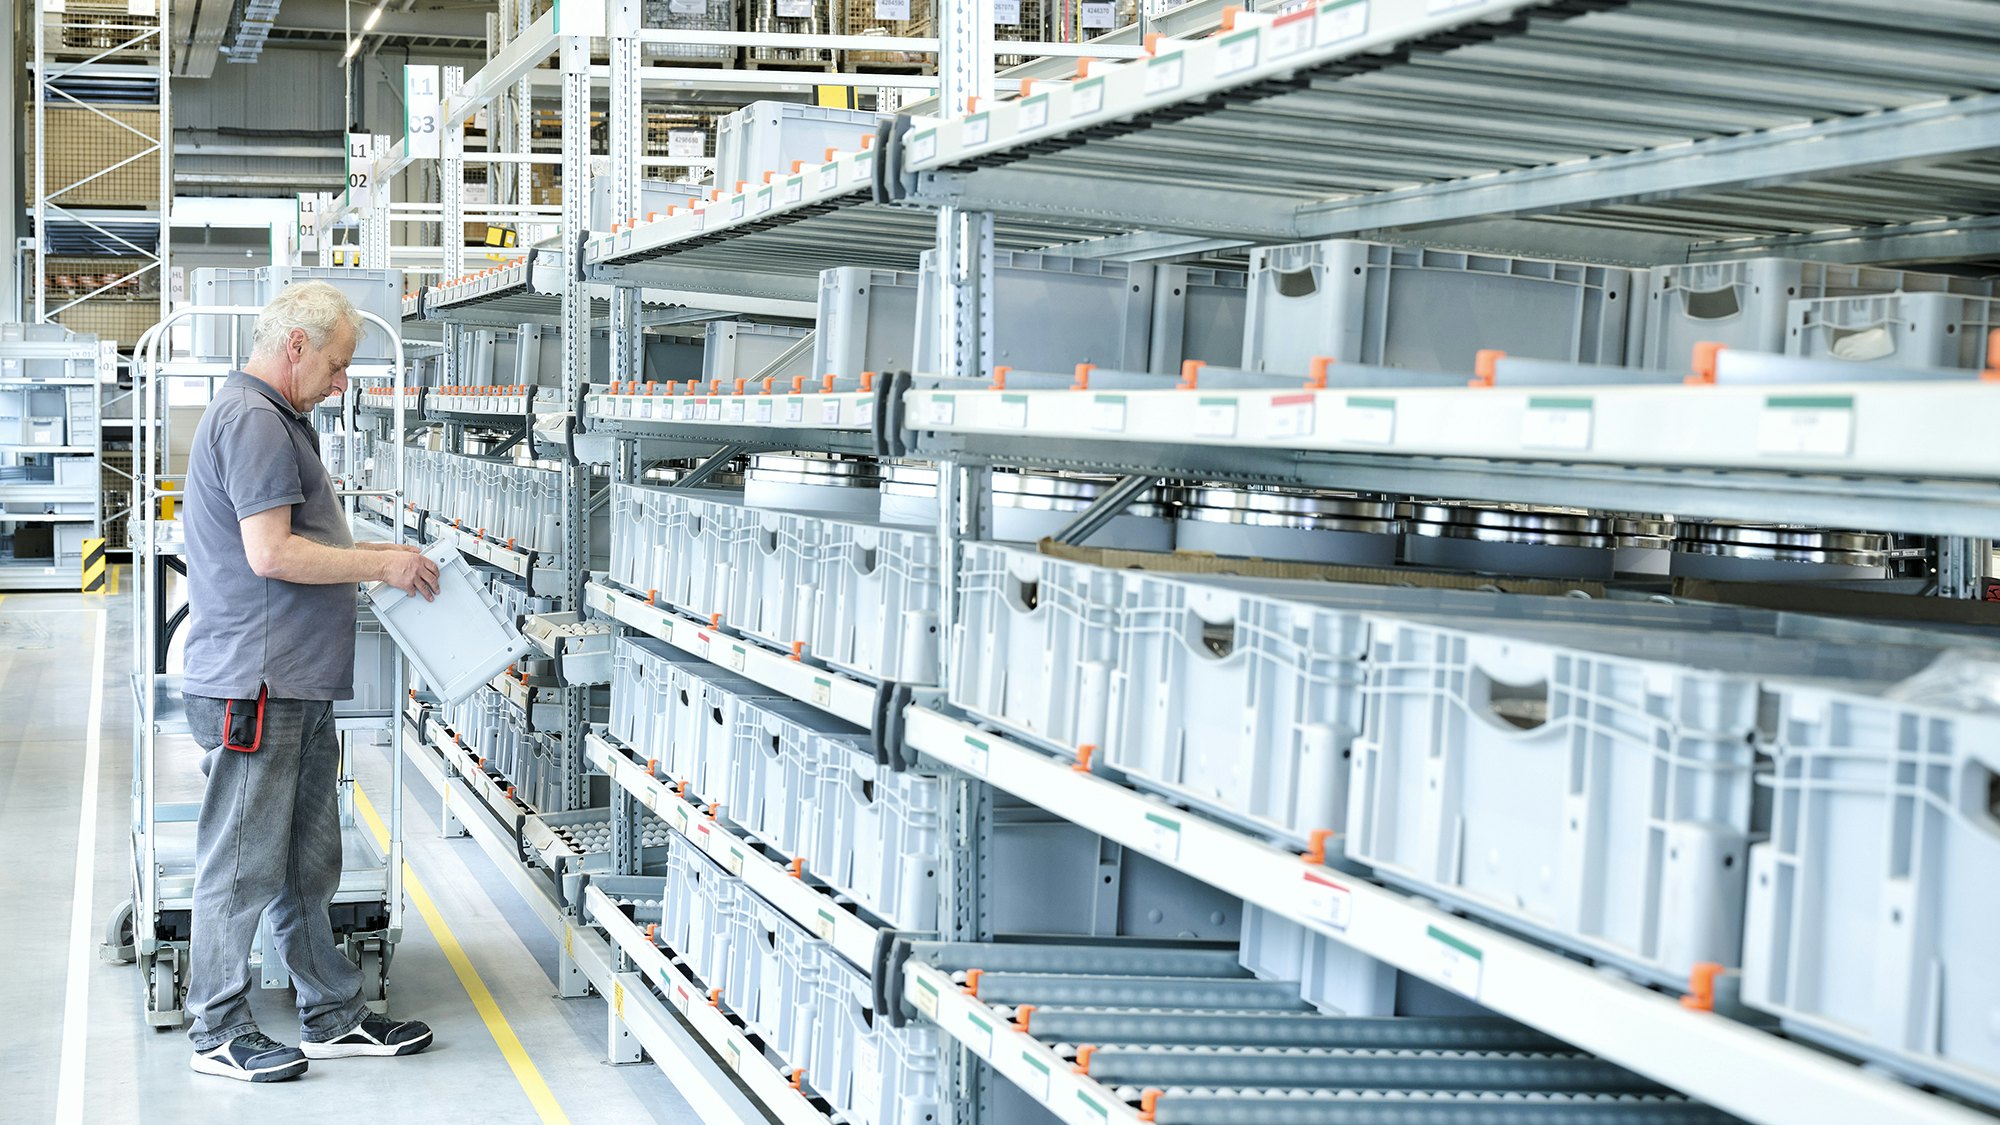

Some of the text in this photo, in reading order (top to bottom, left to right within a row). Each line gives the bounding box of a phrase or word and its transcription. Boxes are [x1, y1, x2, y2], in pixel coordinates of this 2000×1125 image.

[411, 78, 433, 95] L1
[410, 115, 435, 133] 03
[351, 143, 367, 158] L1
[350, 173, 368, 188] 02
[301, 201, 314, 213] L1
[300, 224, 314, 236] 01
[172, 271, 182, 279] HL
[103, 346, 115, 355] LX
[103, 362, 115, 371] 01
